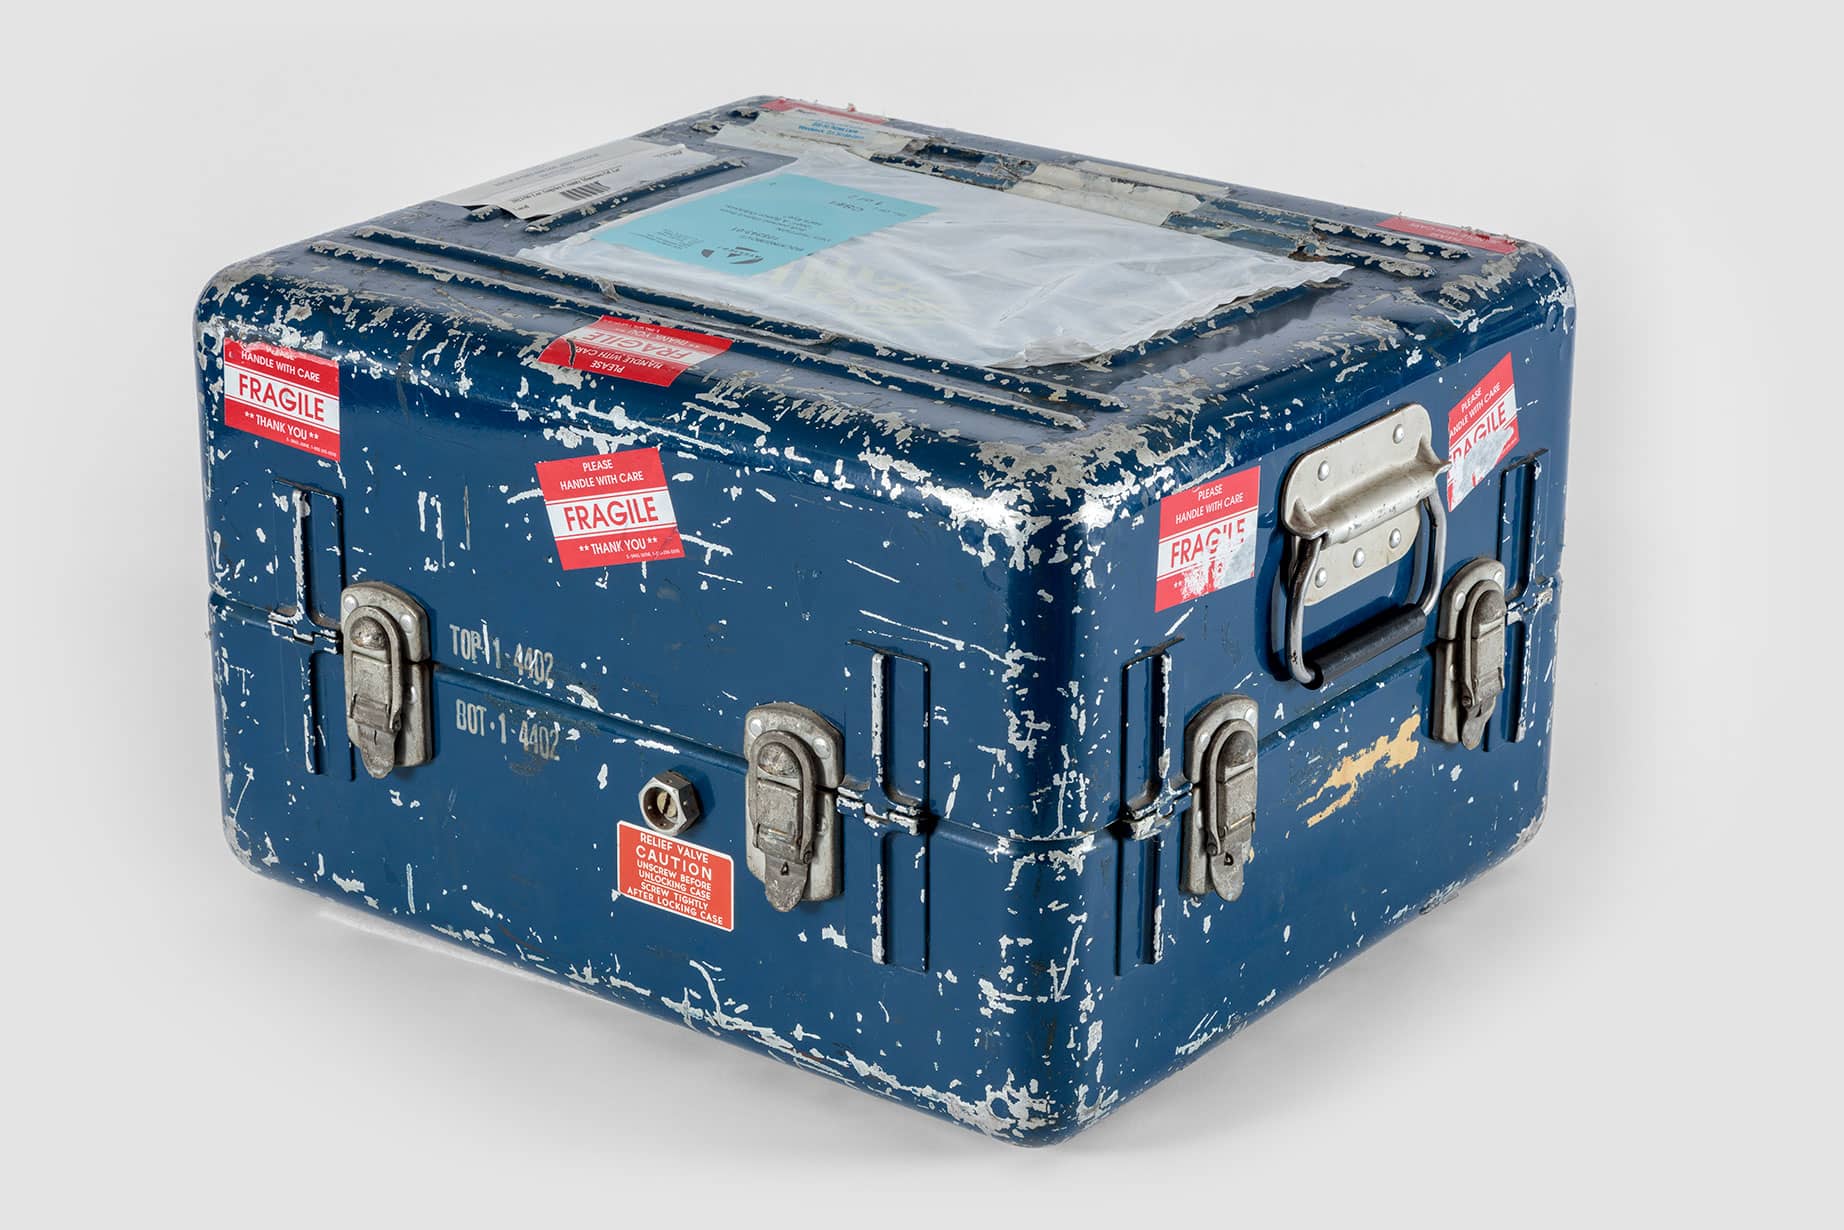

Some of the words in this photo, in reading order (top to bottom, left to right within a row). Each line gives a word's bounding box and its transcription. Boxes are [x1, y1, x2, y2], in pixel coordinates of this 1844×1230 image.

[576, 345, 598, 356] CAR
[582, 331, 692, 359] FRAGILE
[601, 350, 623, 361] WITH
[241, 351, 274, 368] HANDLE
[276, 361, 295, 375] WITH
[297, 367, 320, 383] CARE
[590, 360, 625, 374] PLEASE
[623, 356, 664, 369] HANDLE
[239, 373, 324, 422] FRAGILE
[1450, 414, 1469, 437] ANDLE
[1469, 399, 1484, 418] WITH
[1484, 382, 1501, 403] CARE
[1461, 387, 1482, 413] PLEASE
[256, 414, 286, 434] THANK
[287, 425, 307, 440] YOU
[582, 459, 614, 472] PLEASE
[559, 476, 595, 491] HANDLE
[595, 474, 618, 487] WITH
[619, 471, 644, 482] CARE
[1198, 484, 1223, 501] PLEASE
[563, 496, 658, 532] FRAGILE
[1175, 505, 1204, 524] HANDLE
[1205, 500, 1223, 513] WITH
[1223, 492, 1244, 508] CARE
[591, 541, 624, 555] THANK
[624, 538, 646, 551] YOU
[640, 832, 673, 851] RELIEF
[677, 845, 708, 864] VALVE
[635, 845, 712, 881] CAUTION
[637, 859, 677, 879] UNSCREW
[680, 874, 711, 891] BEFORE
[638, 869, 687, 892] UNLOCKING
[689, 887, 711, 900] CASE
[640, 881, 669, 897] SCREW
[674, 892, 708, 911] TIGHTLY
[627, 886, 654, 902] AFTER
[657, 895, 697, 916] LOCKING
[700, 911, 723, 925] CASE
